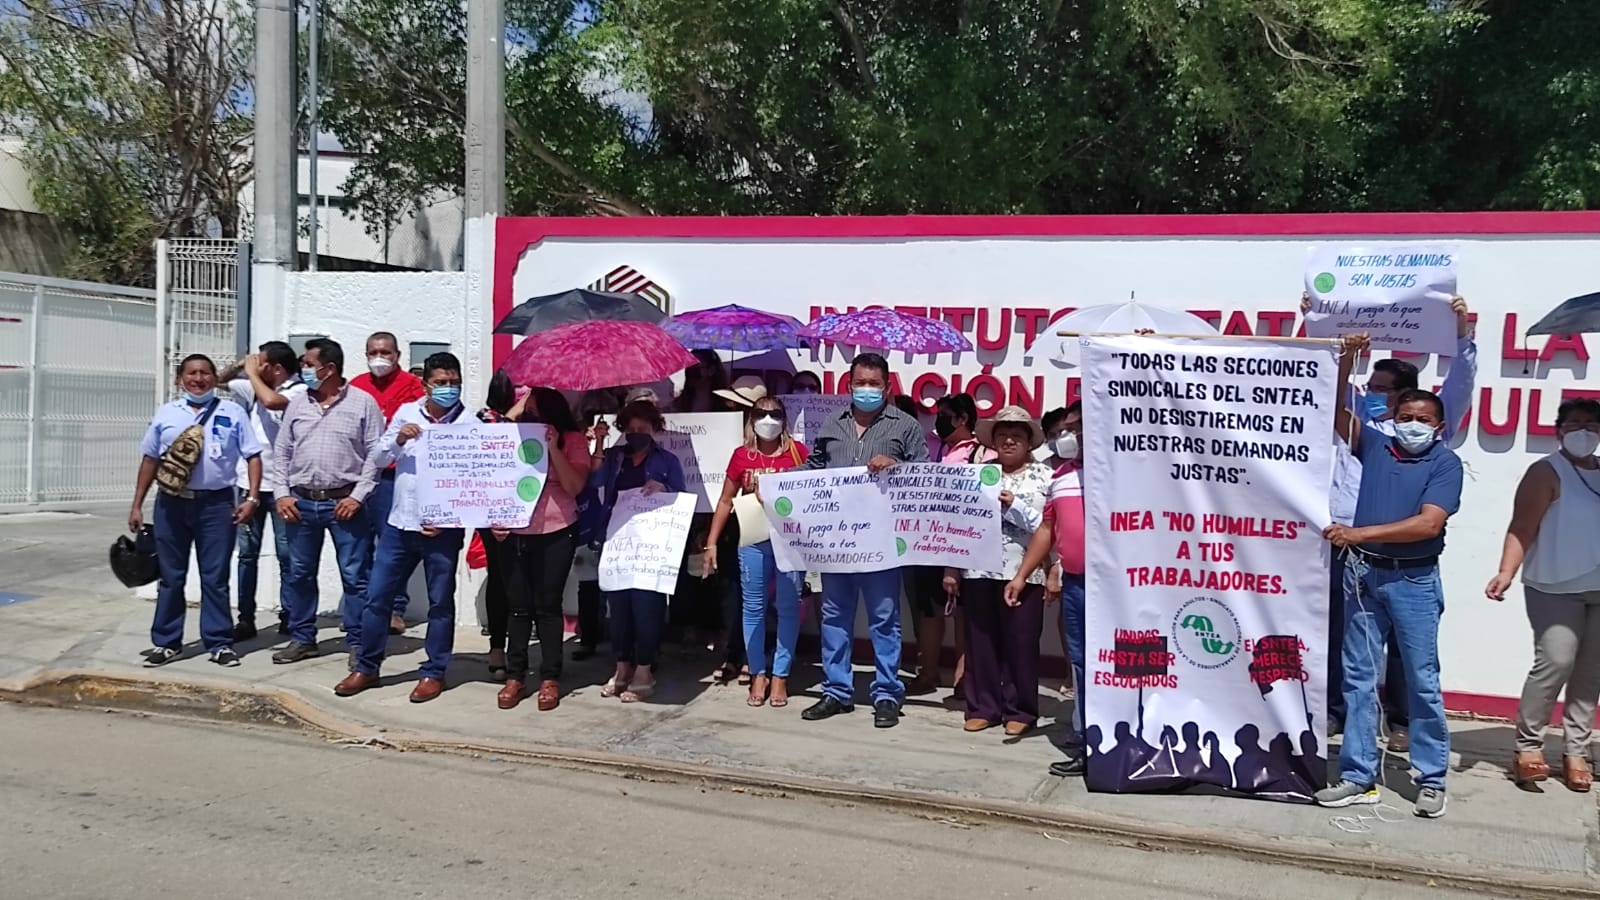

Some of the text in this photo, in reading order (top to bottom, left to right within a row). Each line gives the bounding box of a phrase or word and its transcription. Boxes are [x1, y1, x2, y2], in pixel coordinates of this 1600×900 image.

[1335, 253, 1452, 268] NUESTRAS DEMANDAS
[1348, 273, 1418, 288] SON JUSTAS
[1317, 299, 1423, 319] INEA paga lo que
[1336, 319, 1386, 329] adeudas
[1400, 319, 1421, 330] tus
[1111, 352, 1319, 379] "TODAS LAS SECCIONES
[1108, 380, 1207, 401] SINDICALES
[1213, 384, 1246, 403] DEL
[1252, 385, 1320, 410] SNTEA,
[1120, 407, 1304, 435] NO DESISTIREMOS EN
[481, 441, 516, 451] SNTEA
[1114, 434, 1310, 463] NUESTRAS DEMANDAS
[429, 452, 444, 461] NO
[500, 451, 514, 460] EN
[904, 464, 921, 475] LAS
[922, 464, 976, 477] SECCIONES
[1170, 463, 1251, 486] JUSTAS".
[778, 478, 827, 491] NUESTRAS
[830, 472, 880, 487] DEMANDAS
[888, 476, 932, 488] SINDICALES
[934, 477, 948, 489] DEL
[460, 490, 467, 498] A
[812, 489, 833, 501] SON
[896, 490, 962, 503] DESISTIREMOS
[963, 494, 979, 504] EN
[802, 501, 840, 514] JUSTAS
[891, 503, 994, 519] STRAS DEMANDAS JUSTAS
[783, 519, 871, 539] INEA paga lo que
[894, 518, 920, 532] INEA
[1110, 511, 1307, 540] INEA "NO HUMILLES"
[789, 538, 824, 549] adeudas
[840, 539, 857, 549] tus
[931, 533, 948, 544] tus
[913, 541, 970, 557] trabajadores
[1176, 541, 1235, 562] A TUS
[1126, 566, 1288, 595] TRABAJADORES.
[1194, 631, 1221, 639] SNTEA
[1243, 638, 1260, 653] EL
[1098, 648, 1176, 667] HASTA SER
[1253, 656, 1304, 669] MERECE
[1093, 671, 1179, 689] ESCUCHADOS
[1250, 670, 1310, 685] RESPETO
